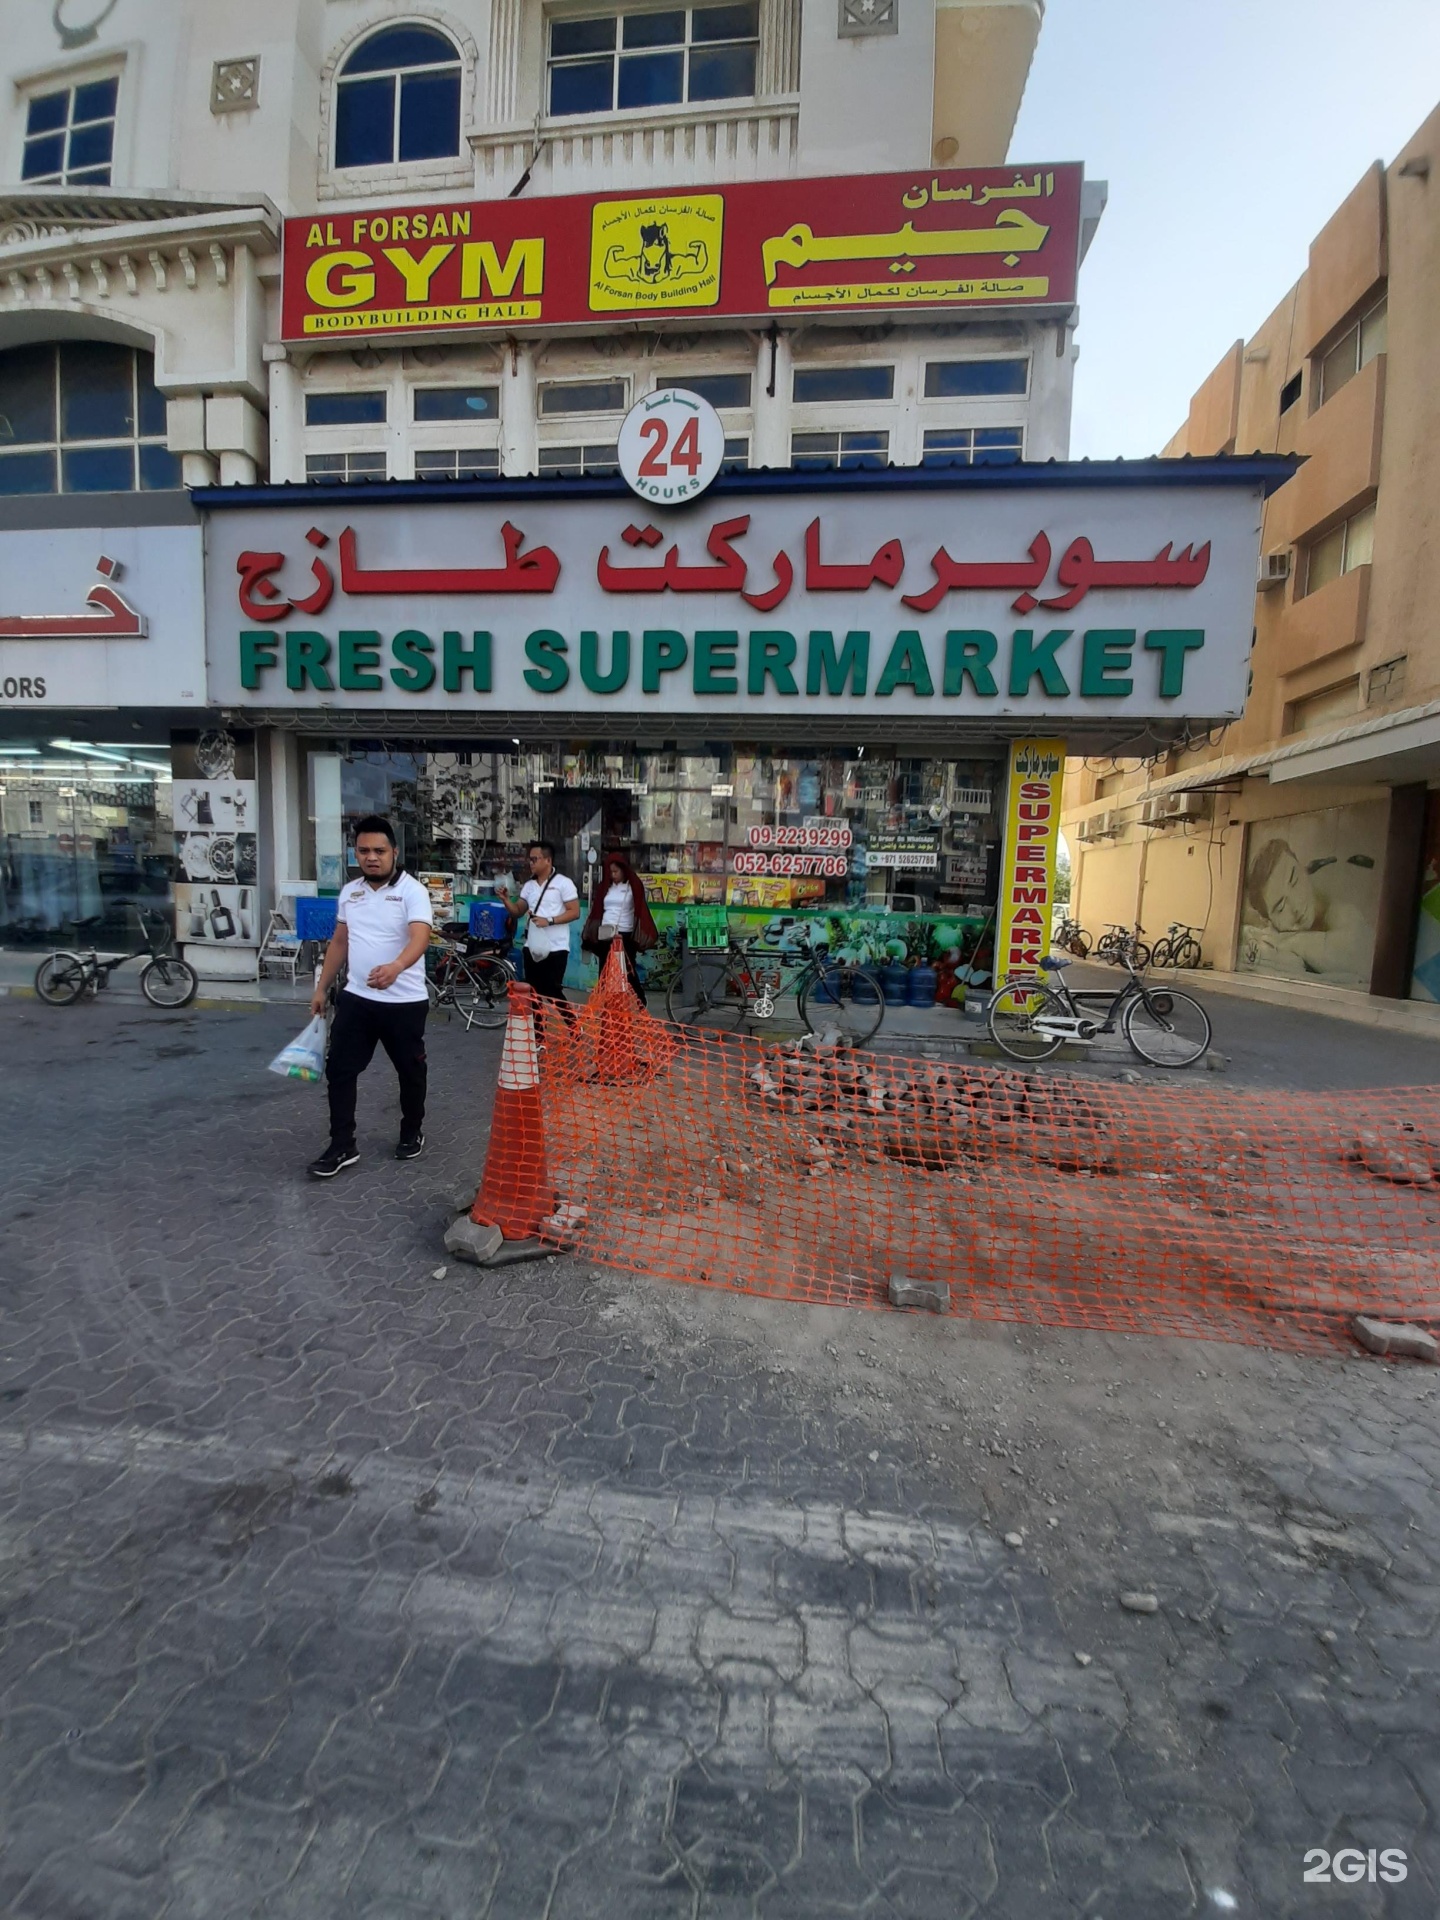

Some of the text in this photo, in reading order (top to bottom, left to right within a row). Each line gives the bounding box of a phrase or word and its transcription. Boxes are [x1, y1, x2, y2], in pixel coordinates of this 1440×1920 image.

[902, 172, 1055, 209] الفرسان
[305, 210, 472, 248] AL FORSAN
[761, 209, 1052, 288] جيم
[305, 238, 545, 308] GYM
[594, 274, 716, 301] Al Forsan Body Building Hall
[857, 286, 900, 299] لكمال
[906, 284, 974, 297] الفرسان
[980, 281, 1024, 292] صالة
[314, 304, 530, 329] BODYBUILDING HALL
[640, 390, 700, 412] ساعة
[638, 417, 702, 477] 24
[635, 477, 700, 499] HOURS
[237, 520, 561, 622] طازج
[239, 629, 1205, 698] FRESH SUPERMARKET
[0, 676, 47, 698] ORS
[750, 827, 851, 847] 09-2239299
[735, 855, 846, 875] 052-6257786
